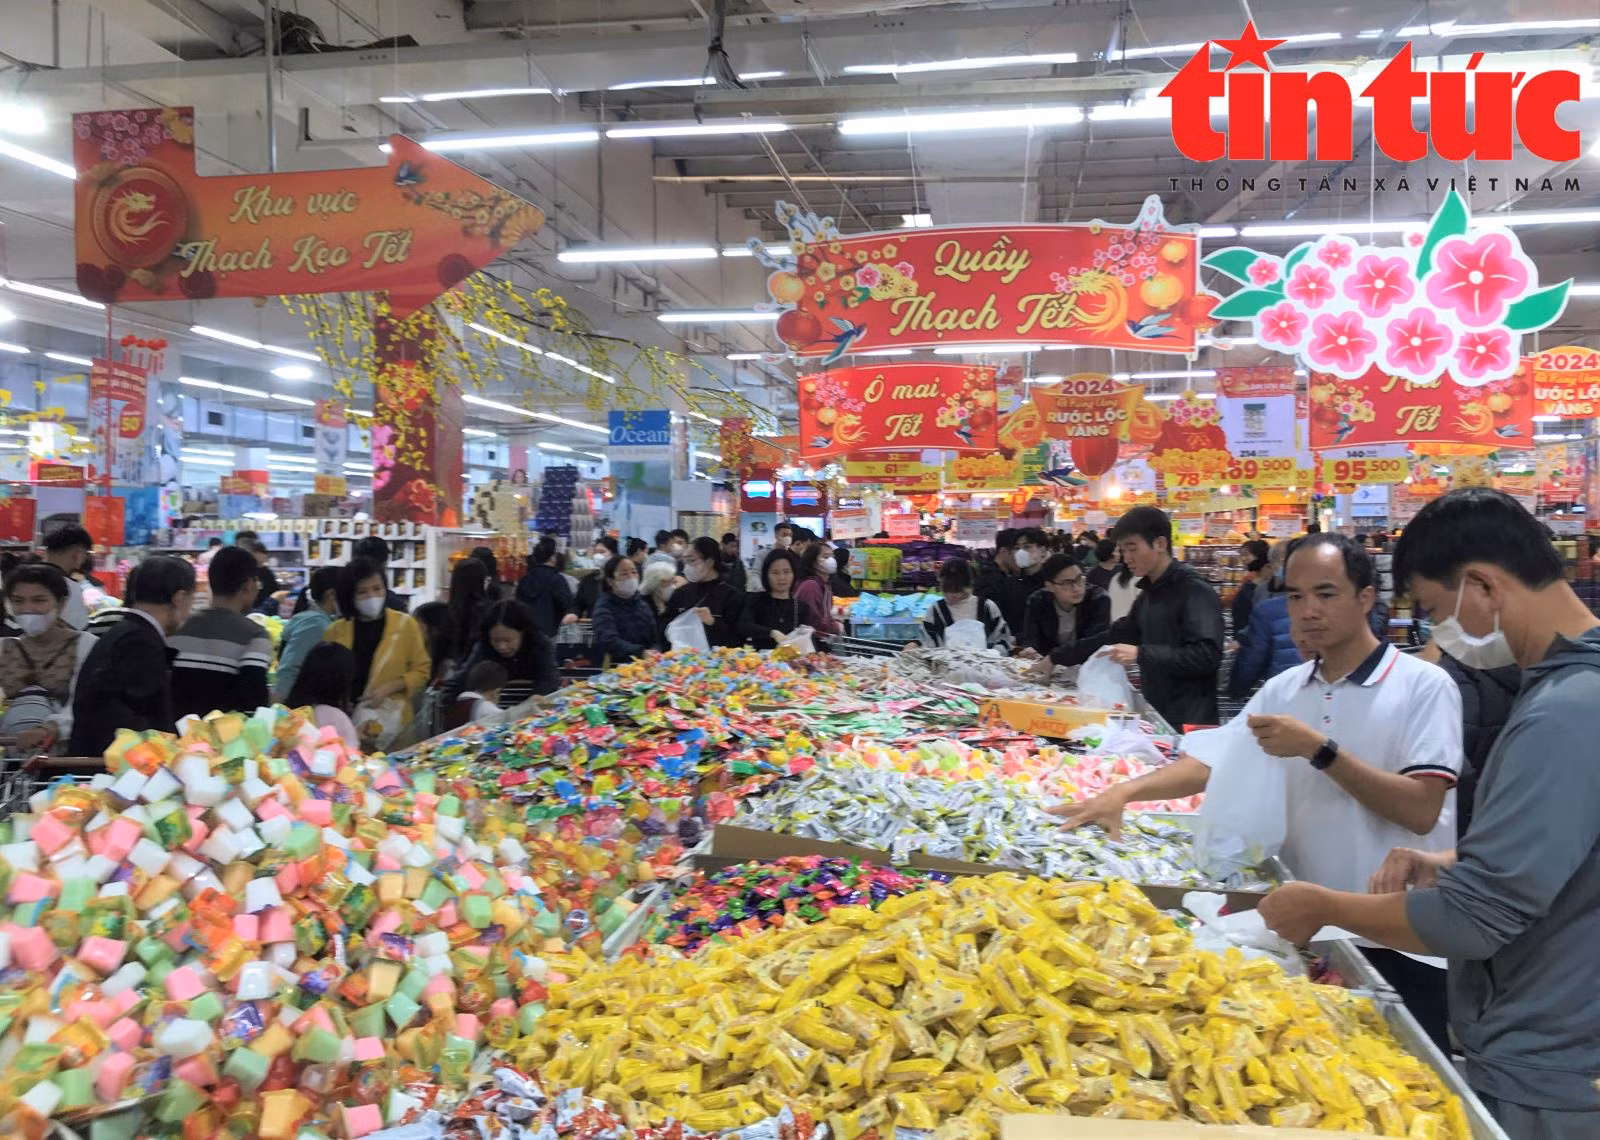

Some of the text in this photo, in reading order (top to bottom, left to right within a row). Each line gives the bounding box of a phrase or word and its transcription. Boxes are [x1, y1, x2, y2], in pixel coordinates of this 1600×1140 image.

[229, 185, 357, 224] Khu vực
[180, 229, 413, 279] Thạch Kẹo Tết
[934, 235, 1031, 284] Quầy
[889, 291, 1078, 338] Thạch Tết
[1541, 353, 1598, 370] 2024
[864, 374, 940, 403] Ô mai
[1062, 379, 1115, 395] 2024
[1534, 384, 1600, 403] ƯỚC LỘ
[1045, 407, 1128, 426] RƯỚC LỘC
[1544, 400, 1594, 415] VÀNG
[885, 412, 924, 440] Tết
[1065, 423, 1110, 437] VÀNG
[1395, 405, 1443, 435] Tết
[611, 425, 669, 443] Ocean
